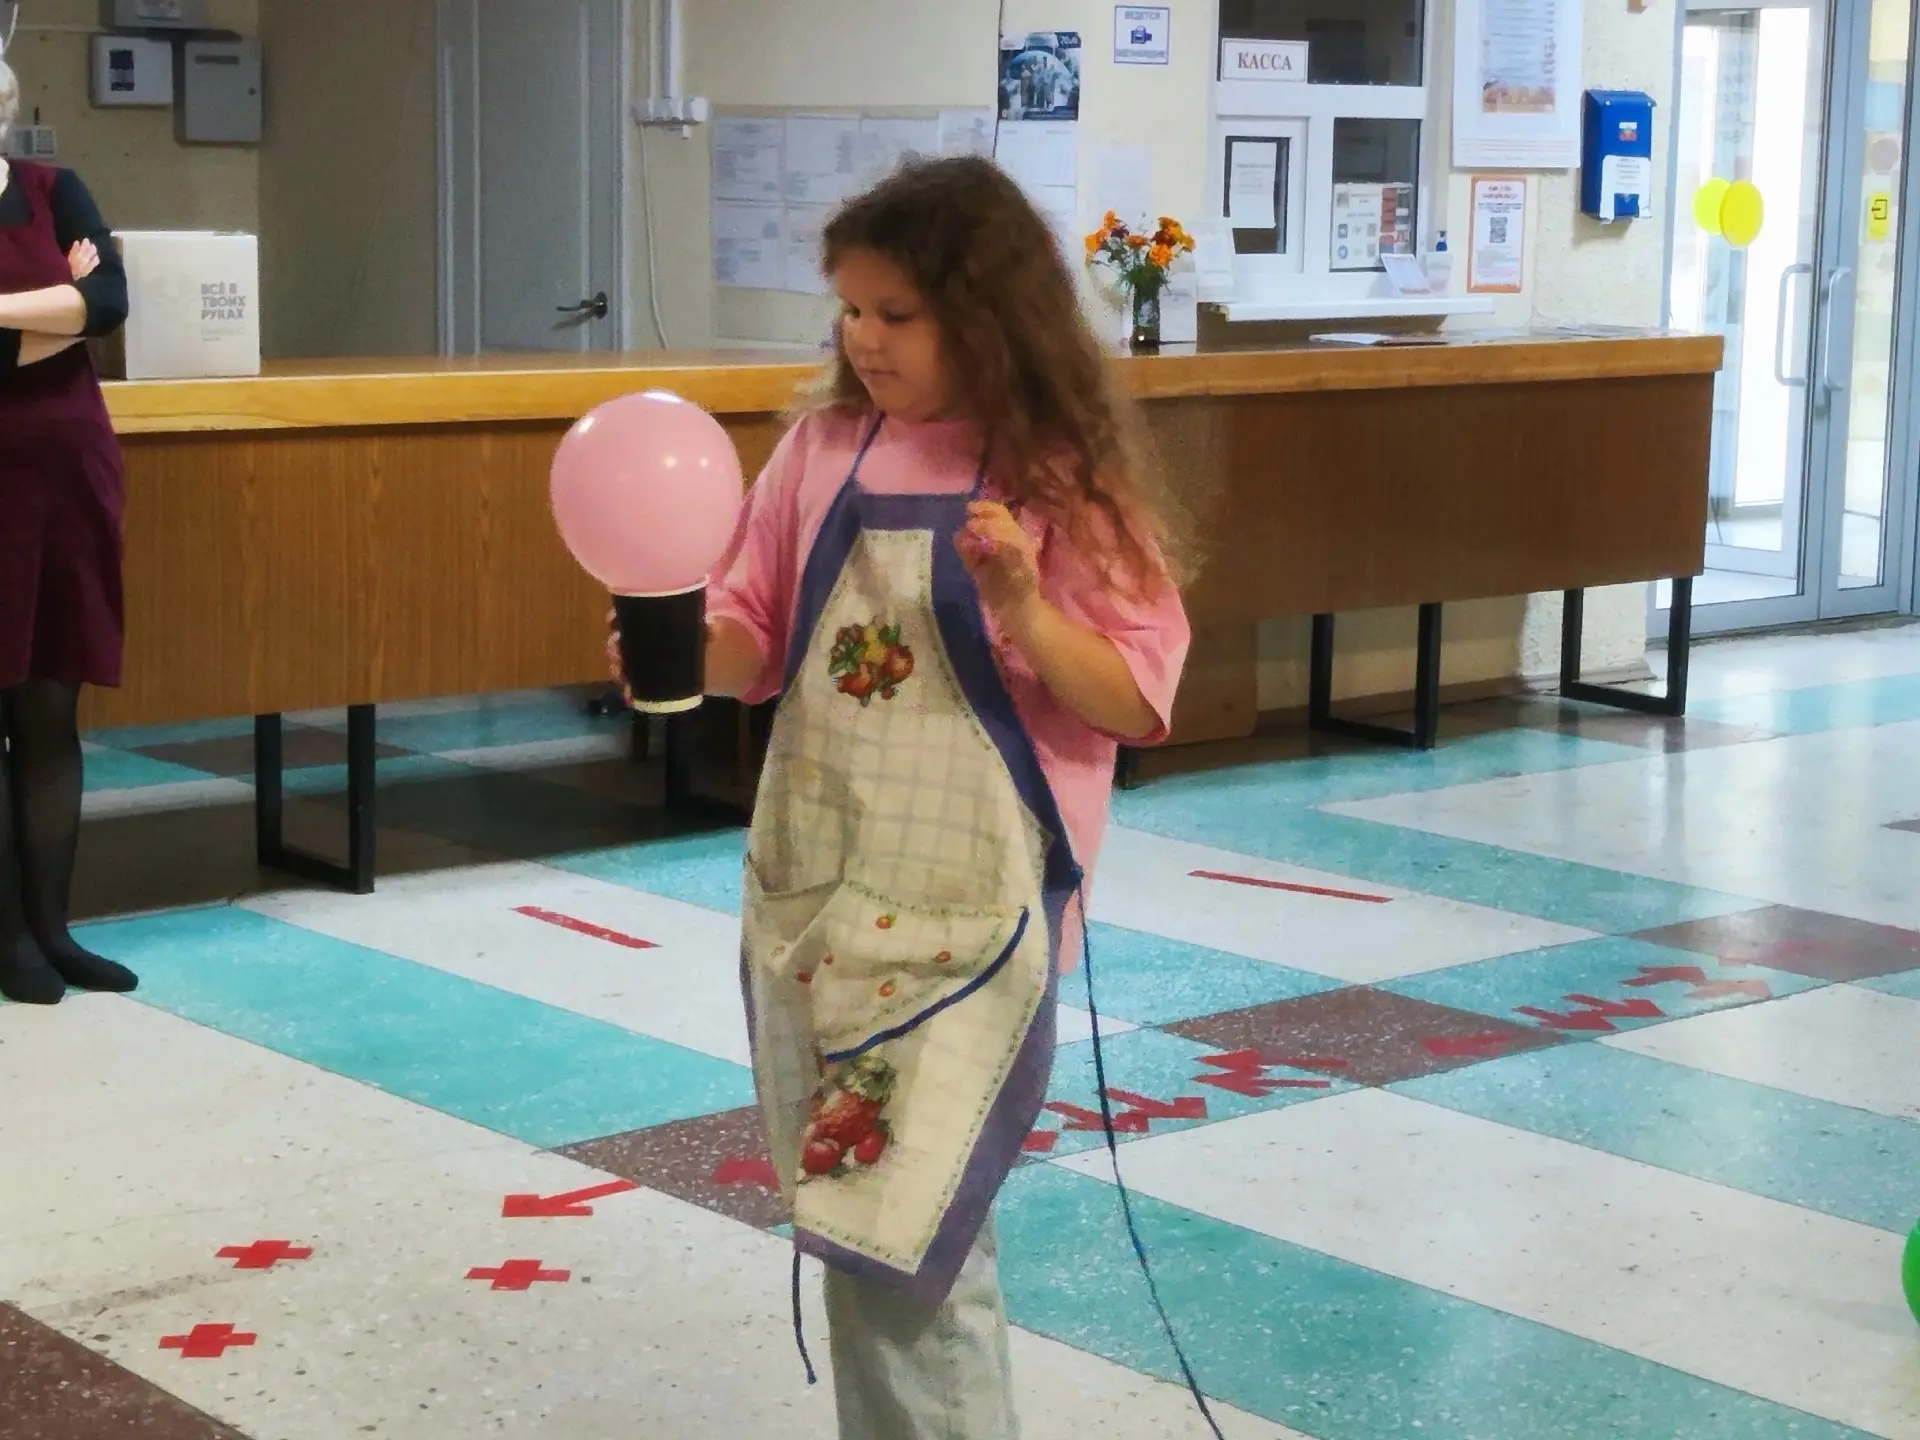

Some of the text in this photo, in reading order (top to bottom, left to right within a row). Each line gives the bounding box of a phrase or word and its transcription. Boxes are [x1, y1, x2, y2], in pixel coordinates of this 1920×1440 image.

[1237, 52, 1292, 71] КАССА
[201, 296, 246, 307] ТВОИХ
[201, 309, 244, 320] РУКАХ
